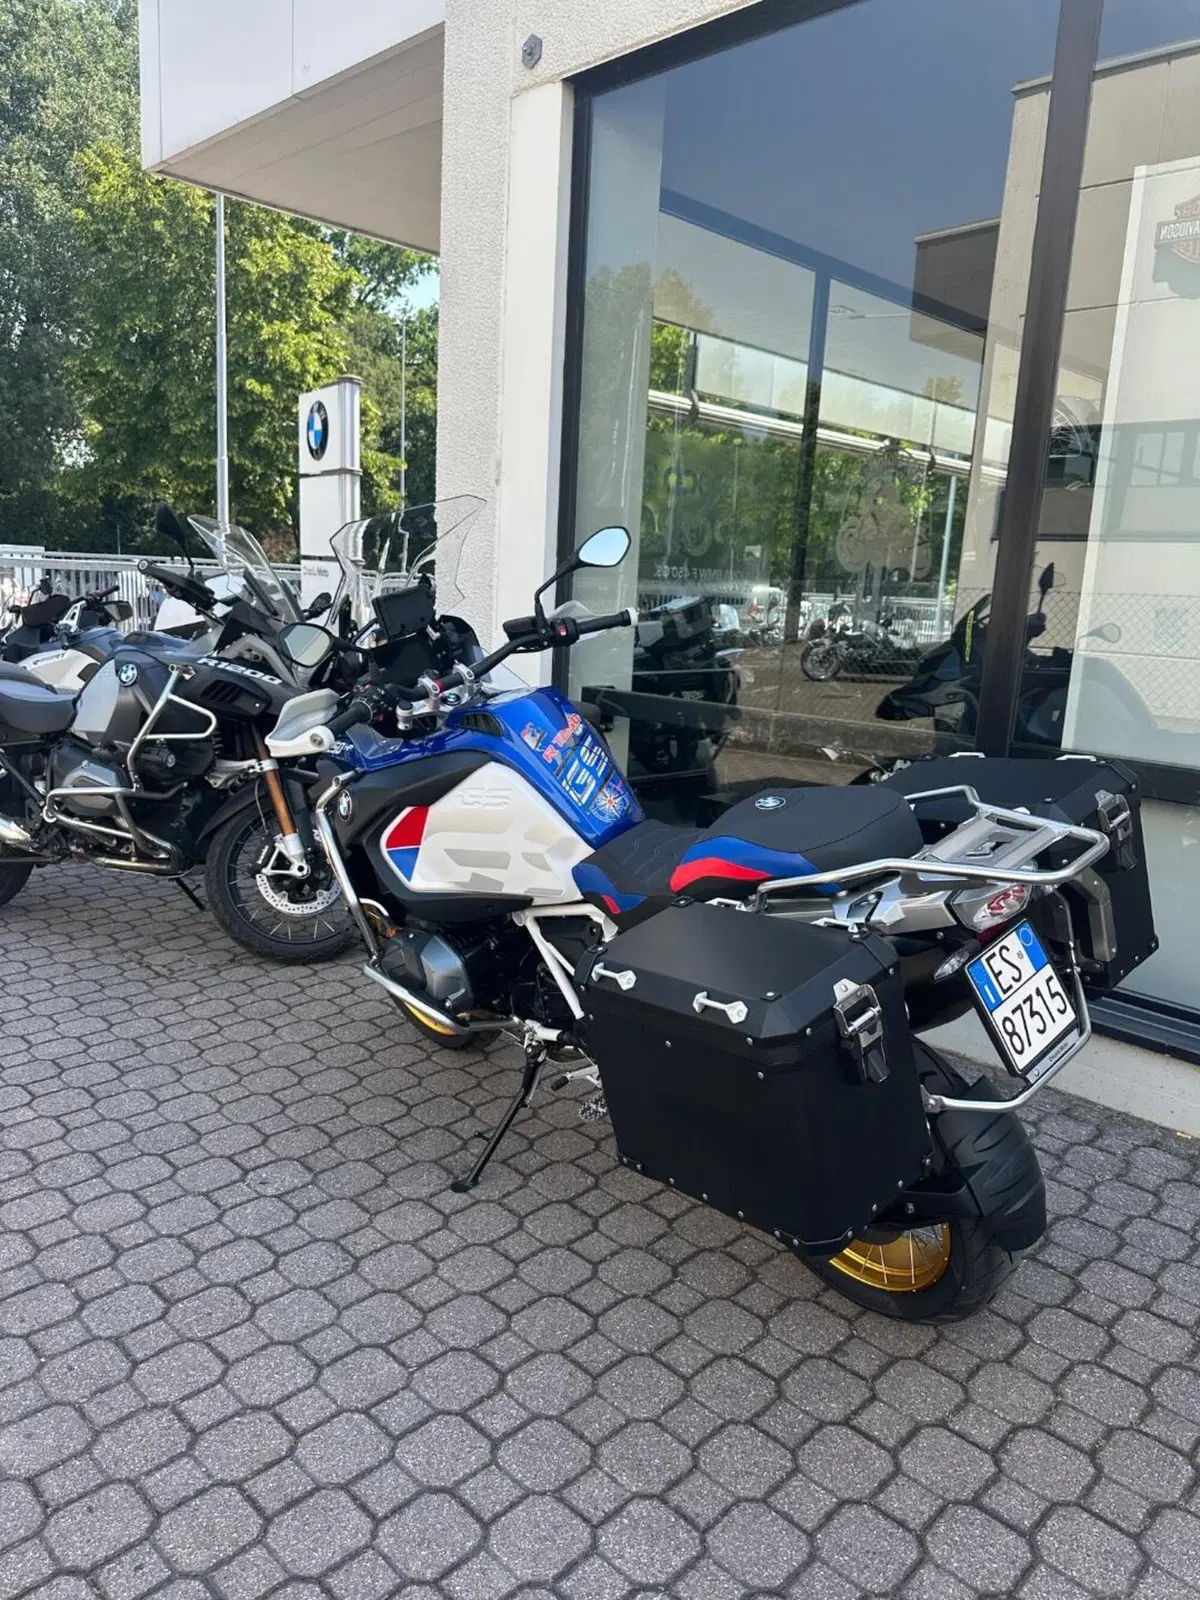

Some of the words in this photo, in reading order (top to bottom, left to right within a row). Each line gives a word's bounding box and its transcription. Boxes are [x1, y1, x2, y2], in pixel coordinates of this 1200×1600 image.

[196, 657, 283, 685] R1200
[562, 735, 608, 806] GS
[456, 787, 512, 810] GS
[985, 945, 1022, 995] ES
[1002, 975, 1067, 1055] 87315
